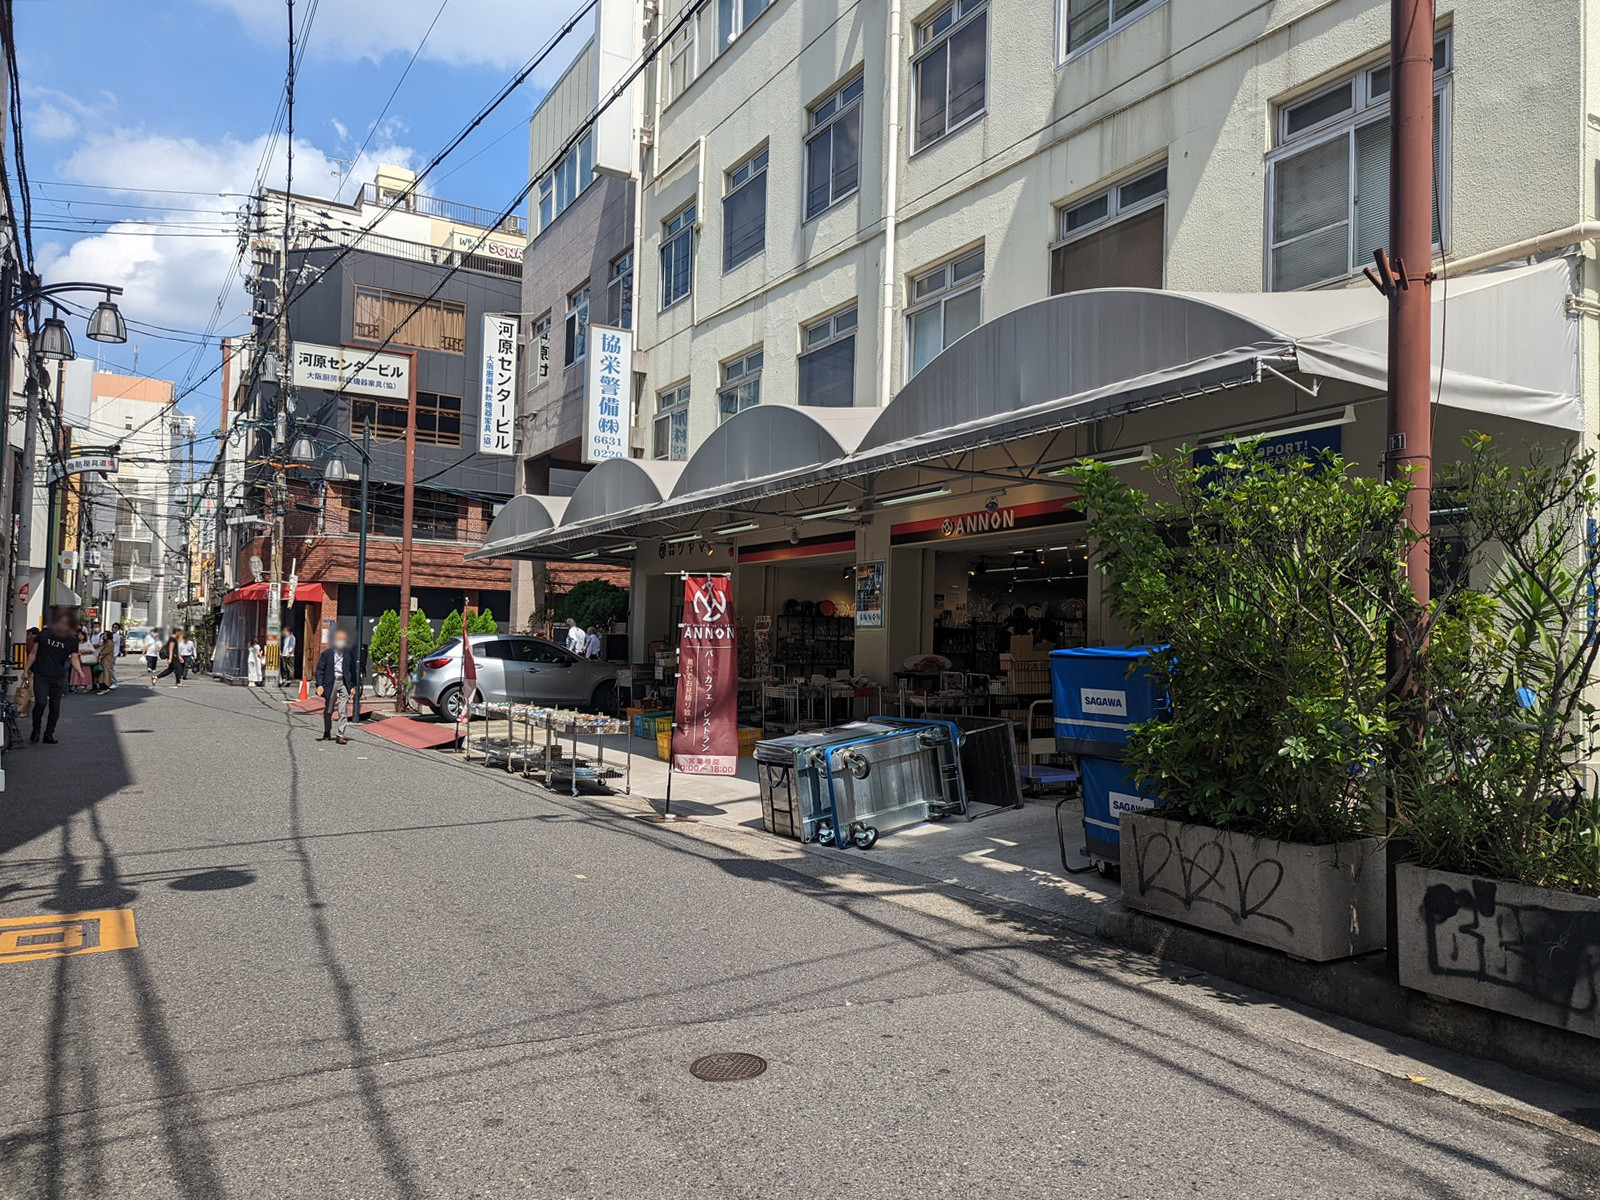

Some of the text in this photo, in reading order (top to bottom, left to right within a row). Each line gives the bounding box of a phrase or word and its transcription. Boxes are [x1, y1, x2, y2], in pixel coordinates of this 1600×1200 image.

[299, 352, 403, 378] 河原センタービル
[495, 321, 514, 450] 河原センタービル
[594, 435, 622, 447] 6631
[955, 509, 1015, 533] ANNON
[684, 627, 735, 640] ANNON
[1084, 696, 1122, 708] SAGAWA
[710, 765, 733, 773] 18:00
[1113, 800, 1148, 812] SAGA
